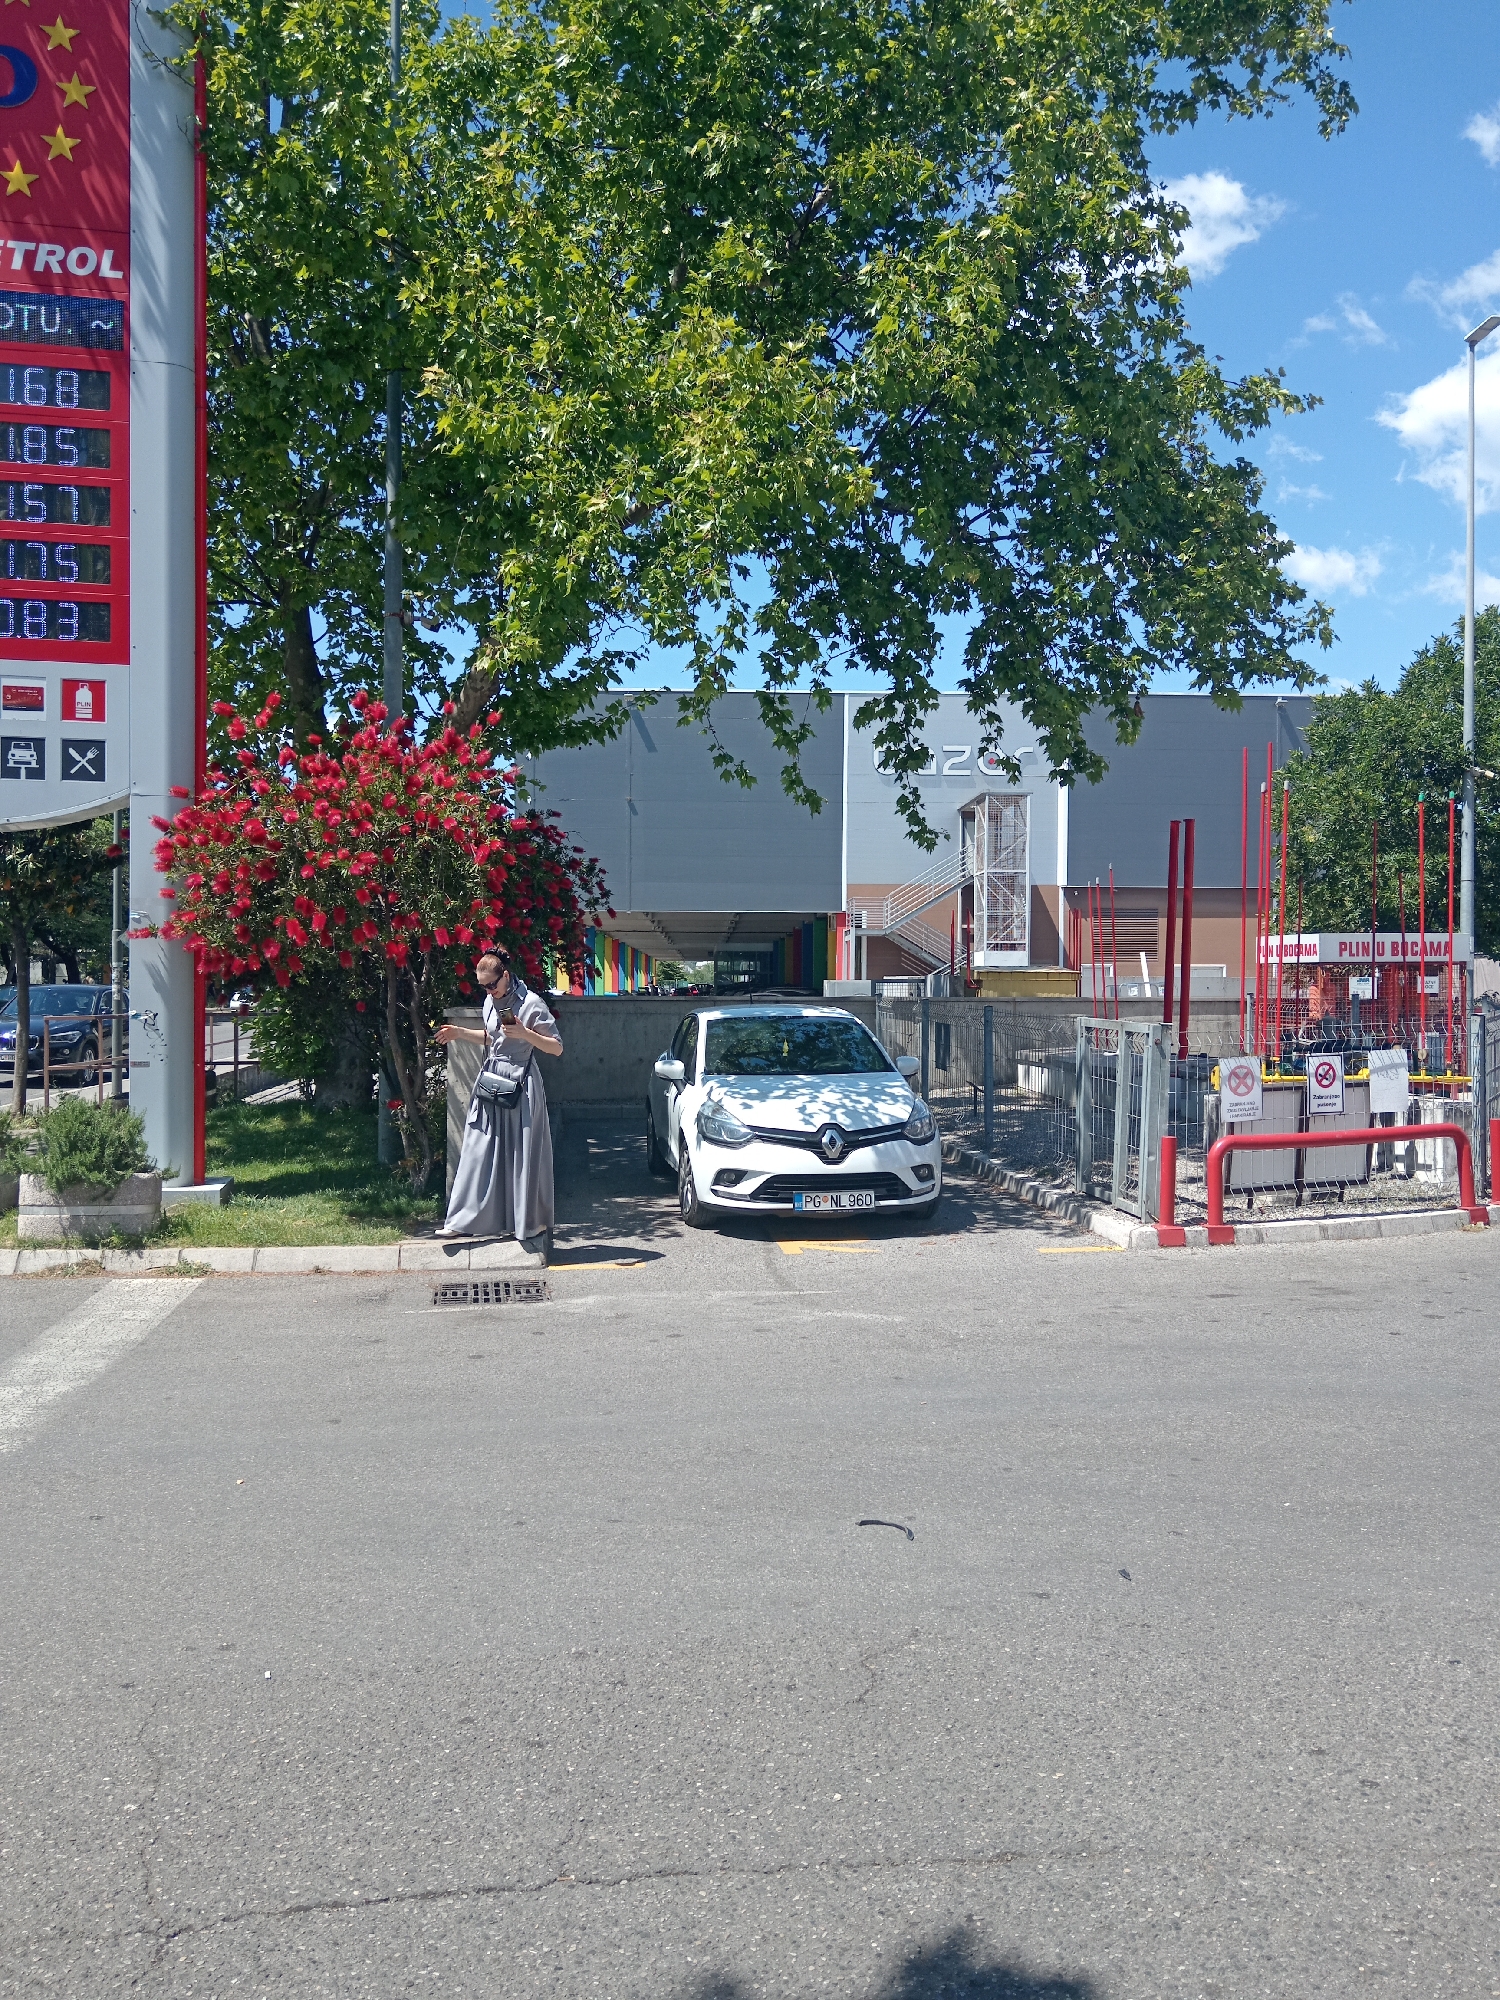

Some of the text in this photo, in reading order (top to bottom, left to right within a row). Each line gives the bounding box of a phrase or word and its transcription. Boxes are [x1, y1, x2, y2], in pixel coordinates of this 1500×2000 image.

[0, 239, 124, 279] TROL
[1338, 940, 1451, 957] PLIN U BOCAMA
[804, 1194, 821, 1208] PG
